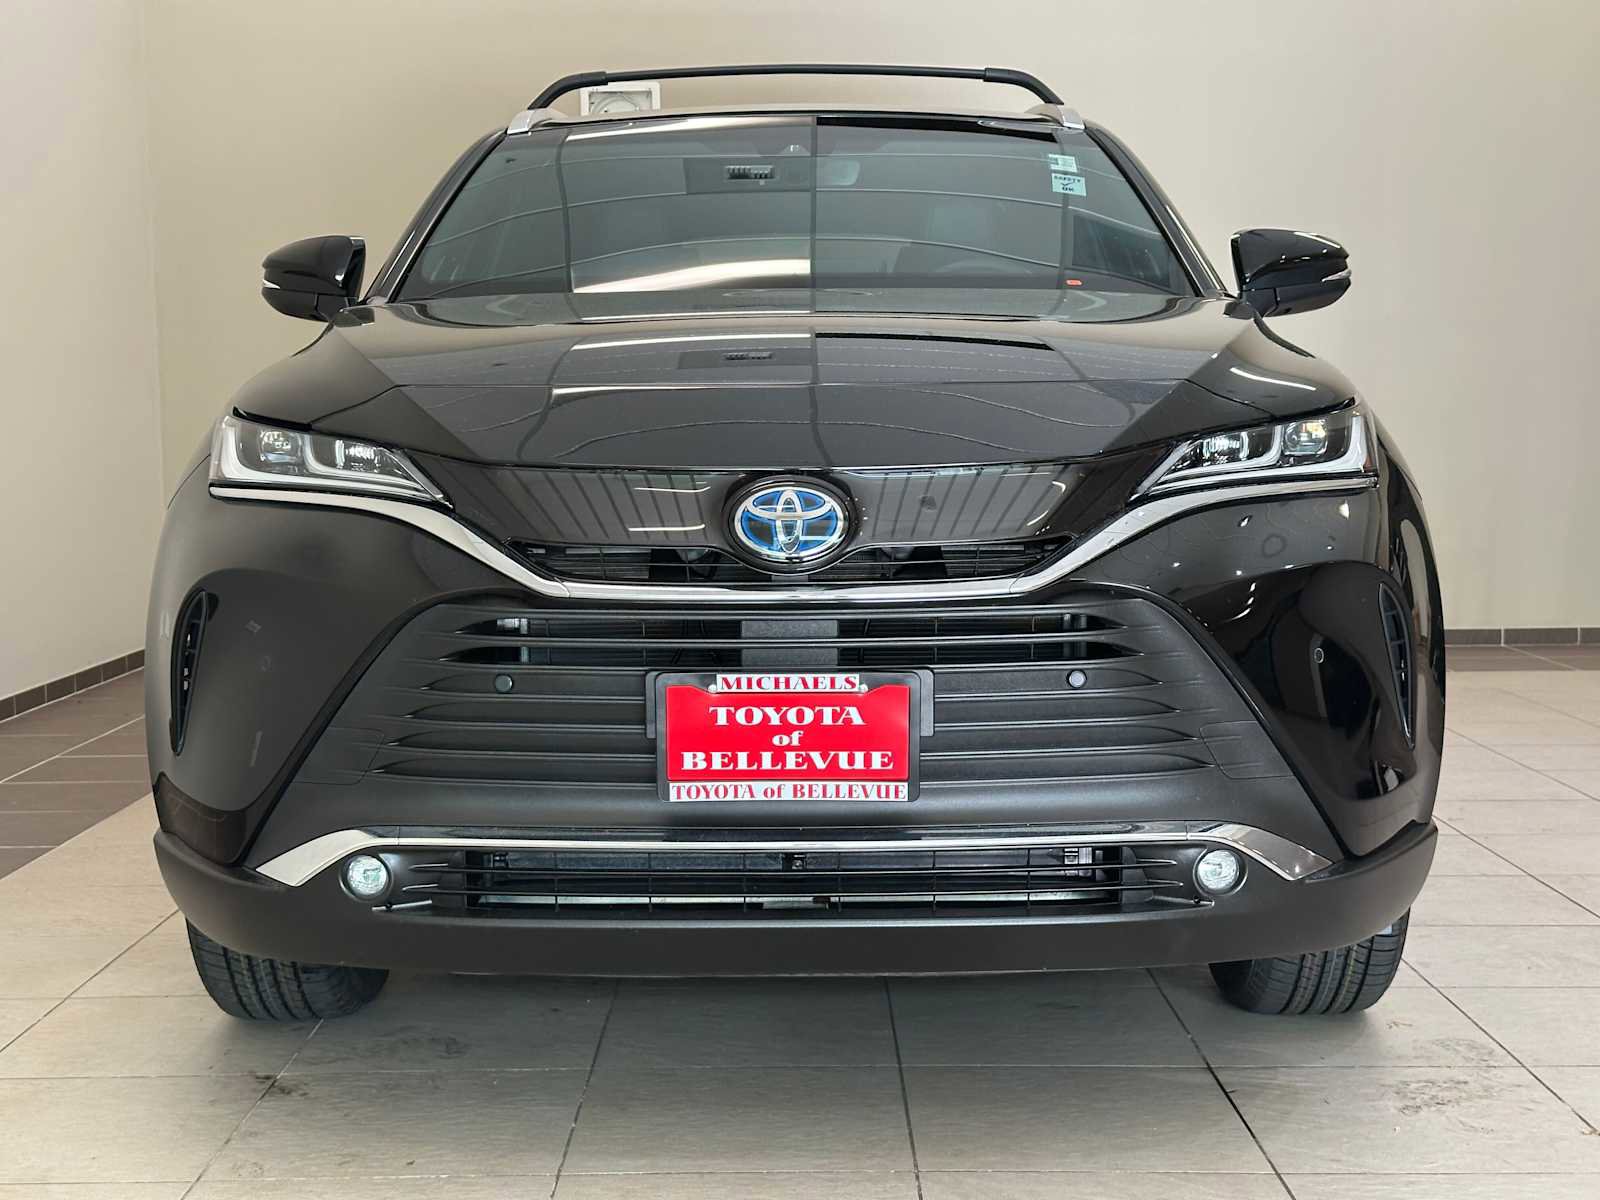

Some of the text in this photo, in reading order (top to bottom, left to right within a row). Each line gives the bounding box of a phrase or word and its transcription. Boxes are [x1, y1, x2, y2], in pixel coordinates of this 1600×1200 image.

[721, 676, 857, 690] MICHAELS
[709, 706, 865, 726] TOYOTA
[772, 730, 804, 747] of
[681, 751, 893, 771] BELLEVUE
[672, 783, 906, 800] TOYOTA of BELLEVUE
